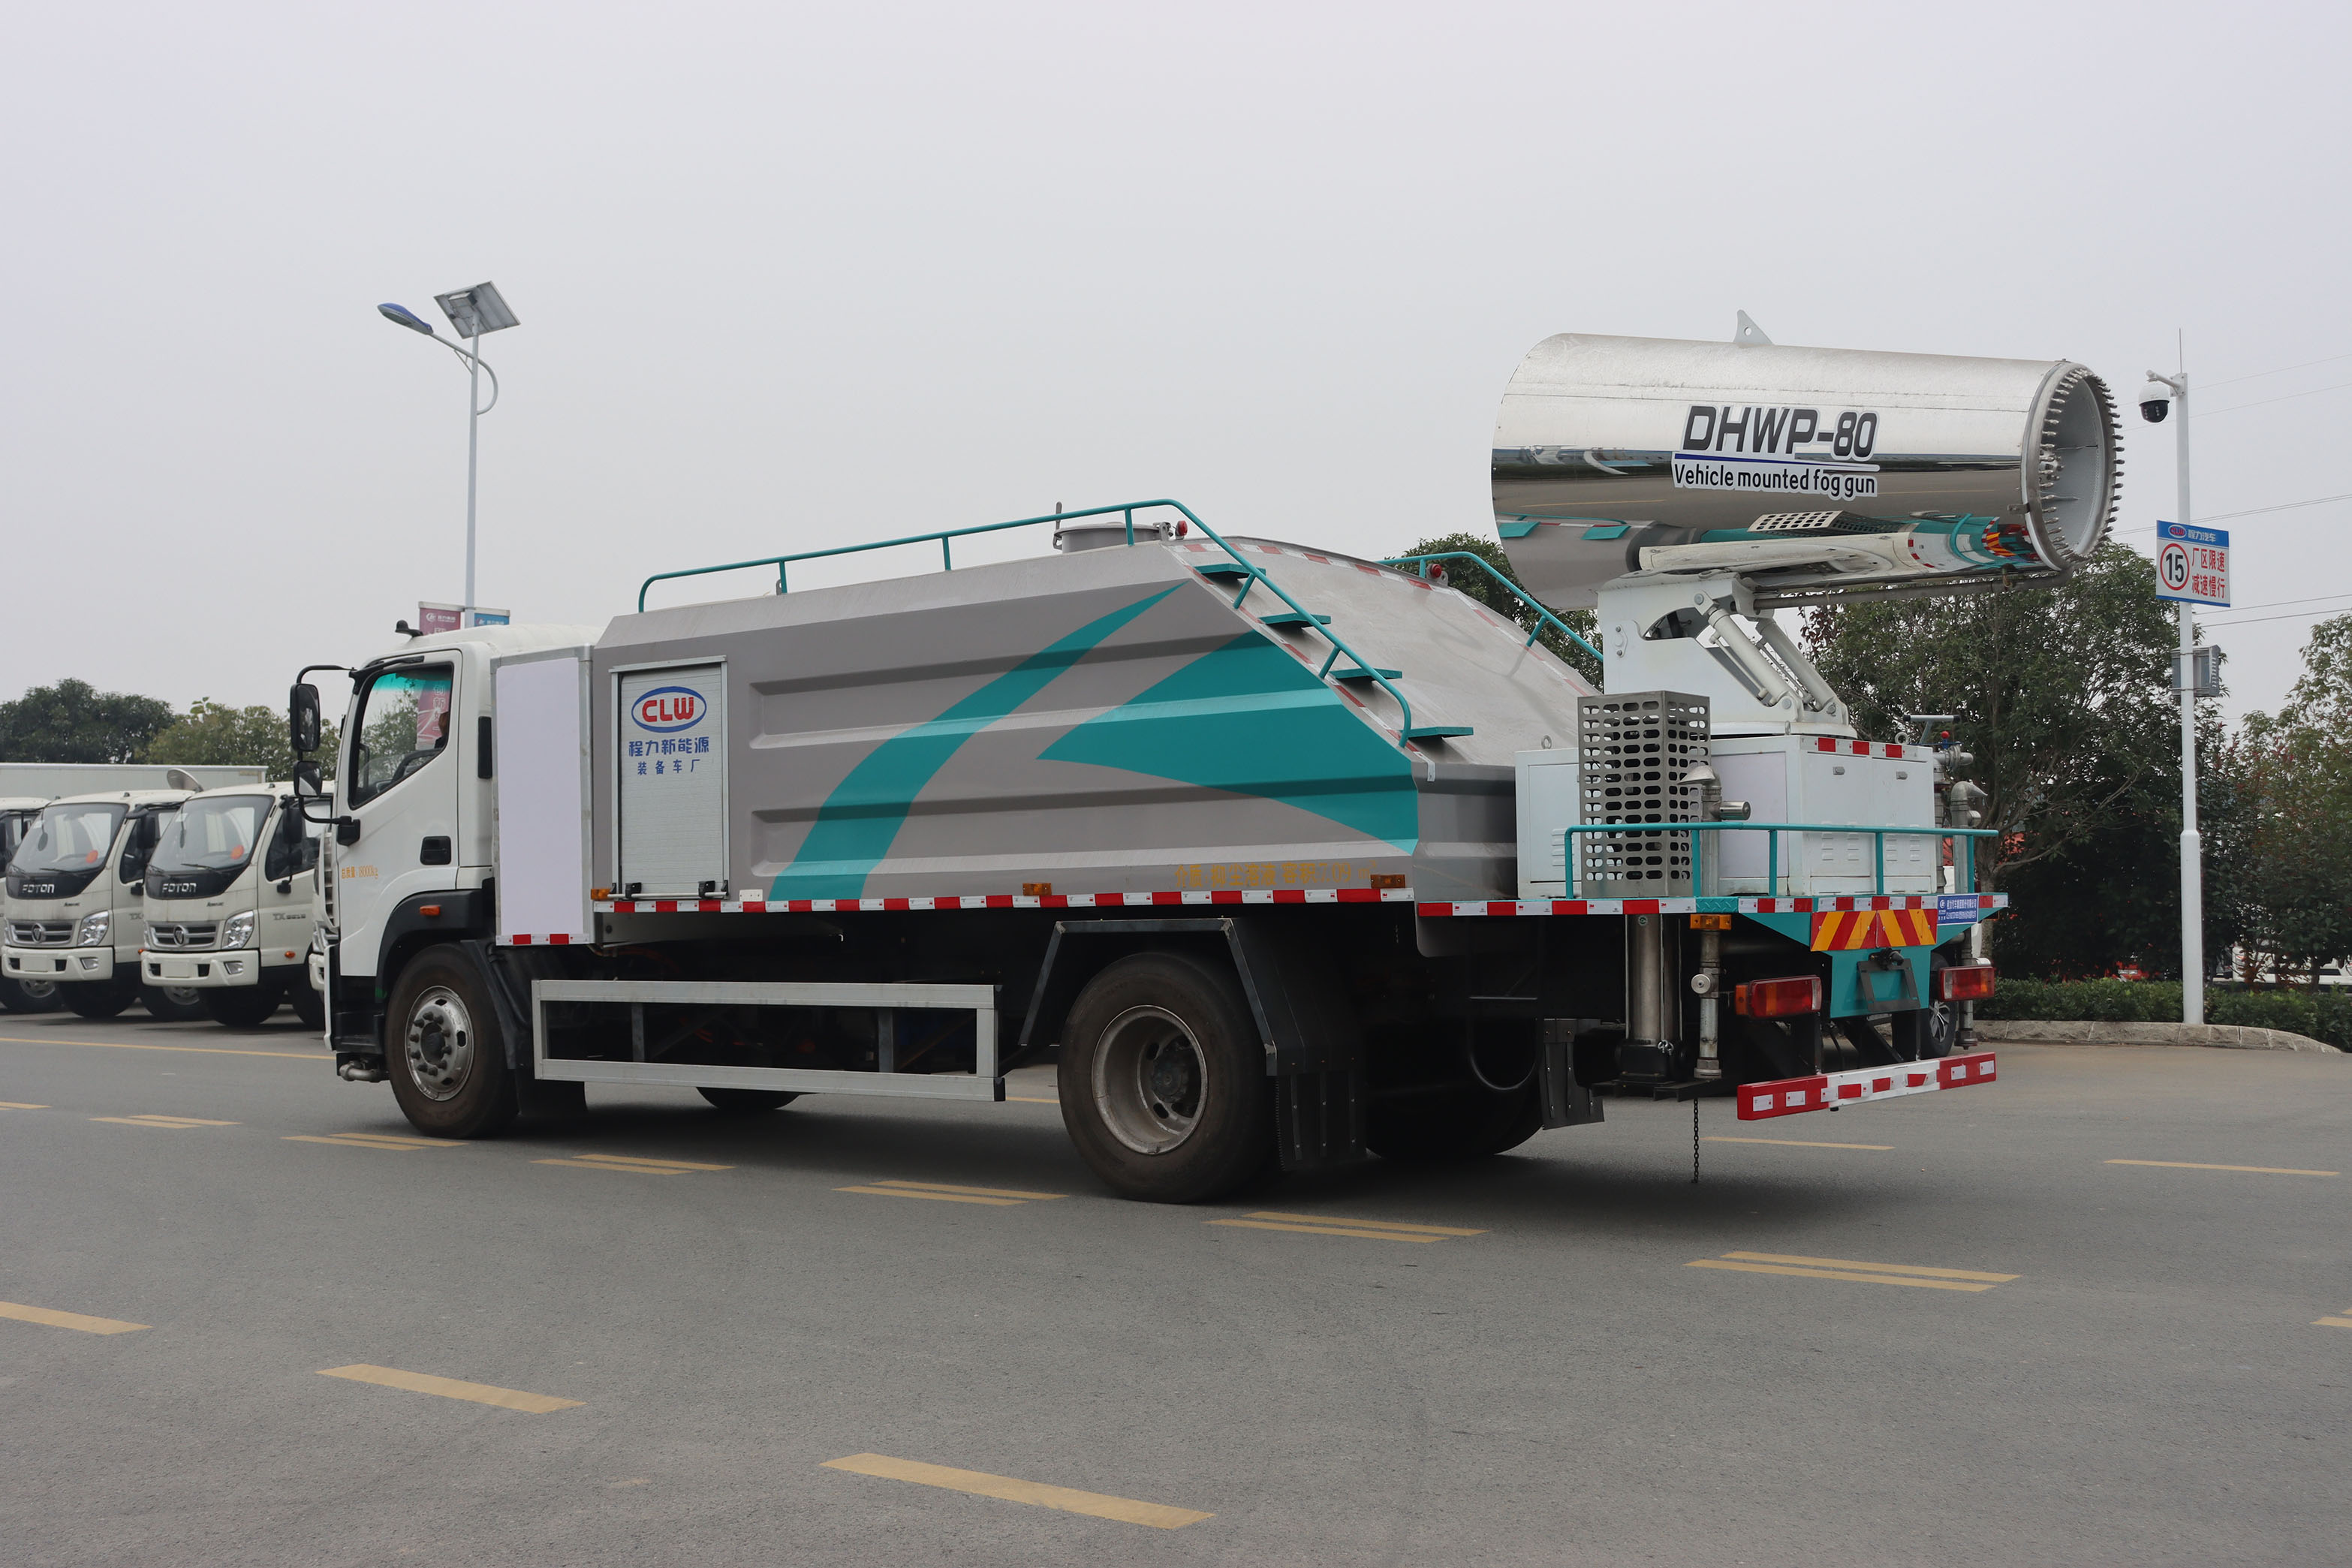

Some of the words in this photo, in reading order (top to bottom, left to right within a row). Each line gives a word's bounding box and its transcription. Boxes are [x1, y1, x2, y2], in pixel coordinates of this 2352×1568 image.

[1682, 405, 1878, 458] DHWP-80
[1674, 463, 1734, 487] Vehicle
[1737, 468, 1809, 490] mounted
[1813, 469, 1840, 497] fog
[1845, 477, 1875, 498] gun
[2166, 552, 2184, 582] 15
[2192, 547, 2225, 573] 厂区限速
[2192, 573, 2225, 599] 减速慢行
[642, 697, 694, 722] CLW
[628, 736, 709, 757] 程力新能源
[637, 759, 700, 775] 装备车厂
[22, 883, 55, 893] FOTON
[161, 883, 197, 893] FOTON
